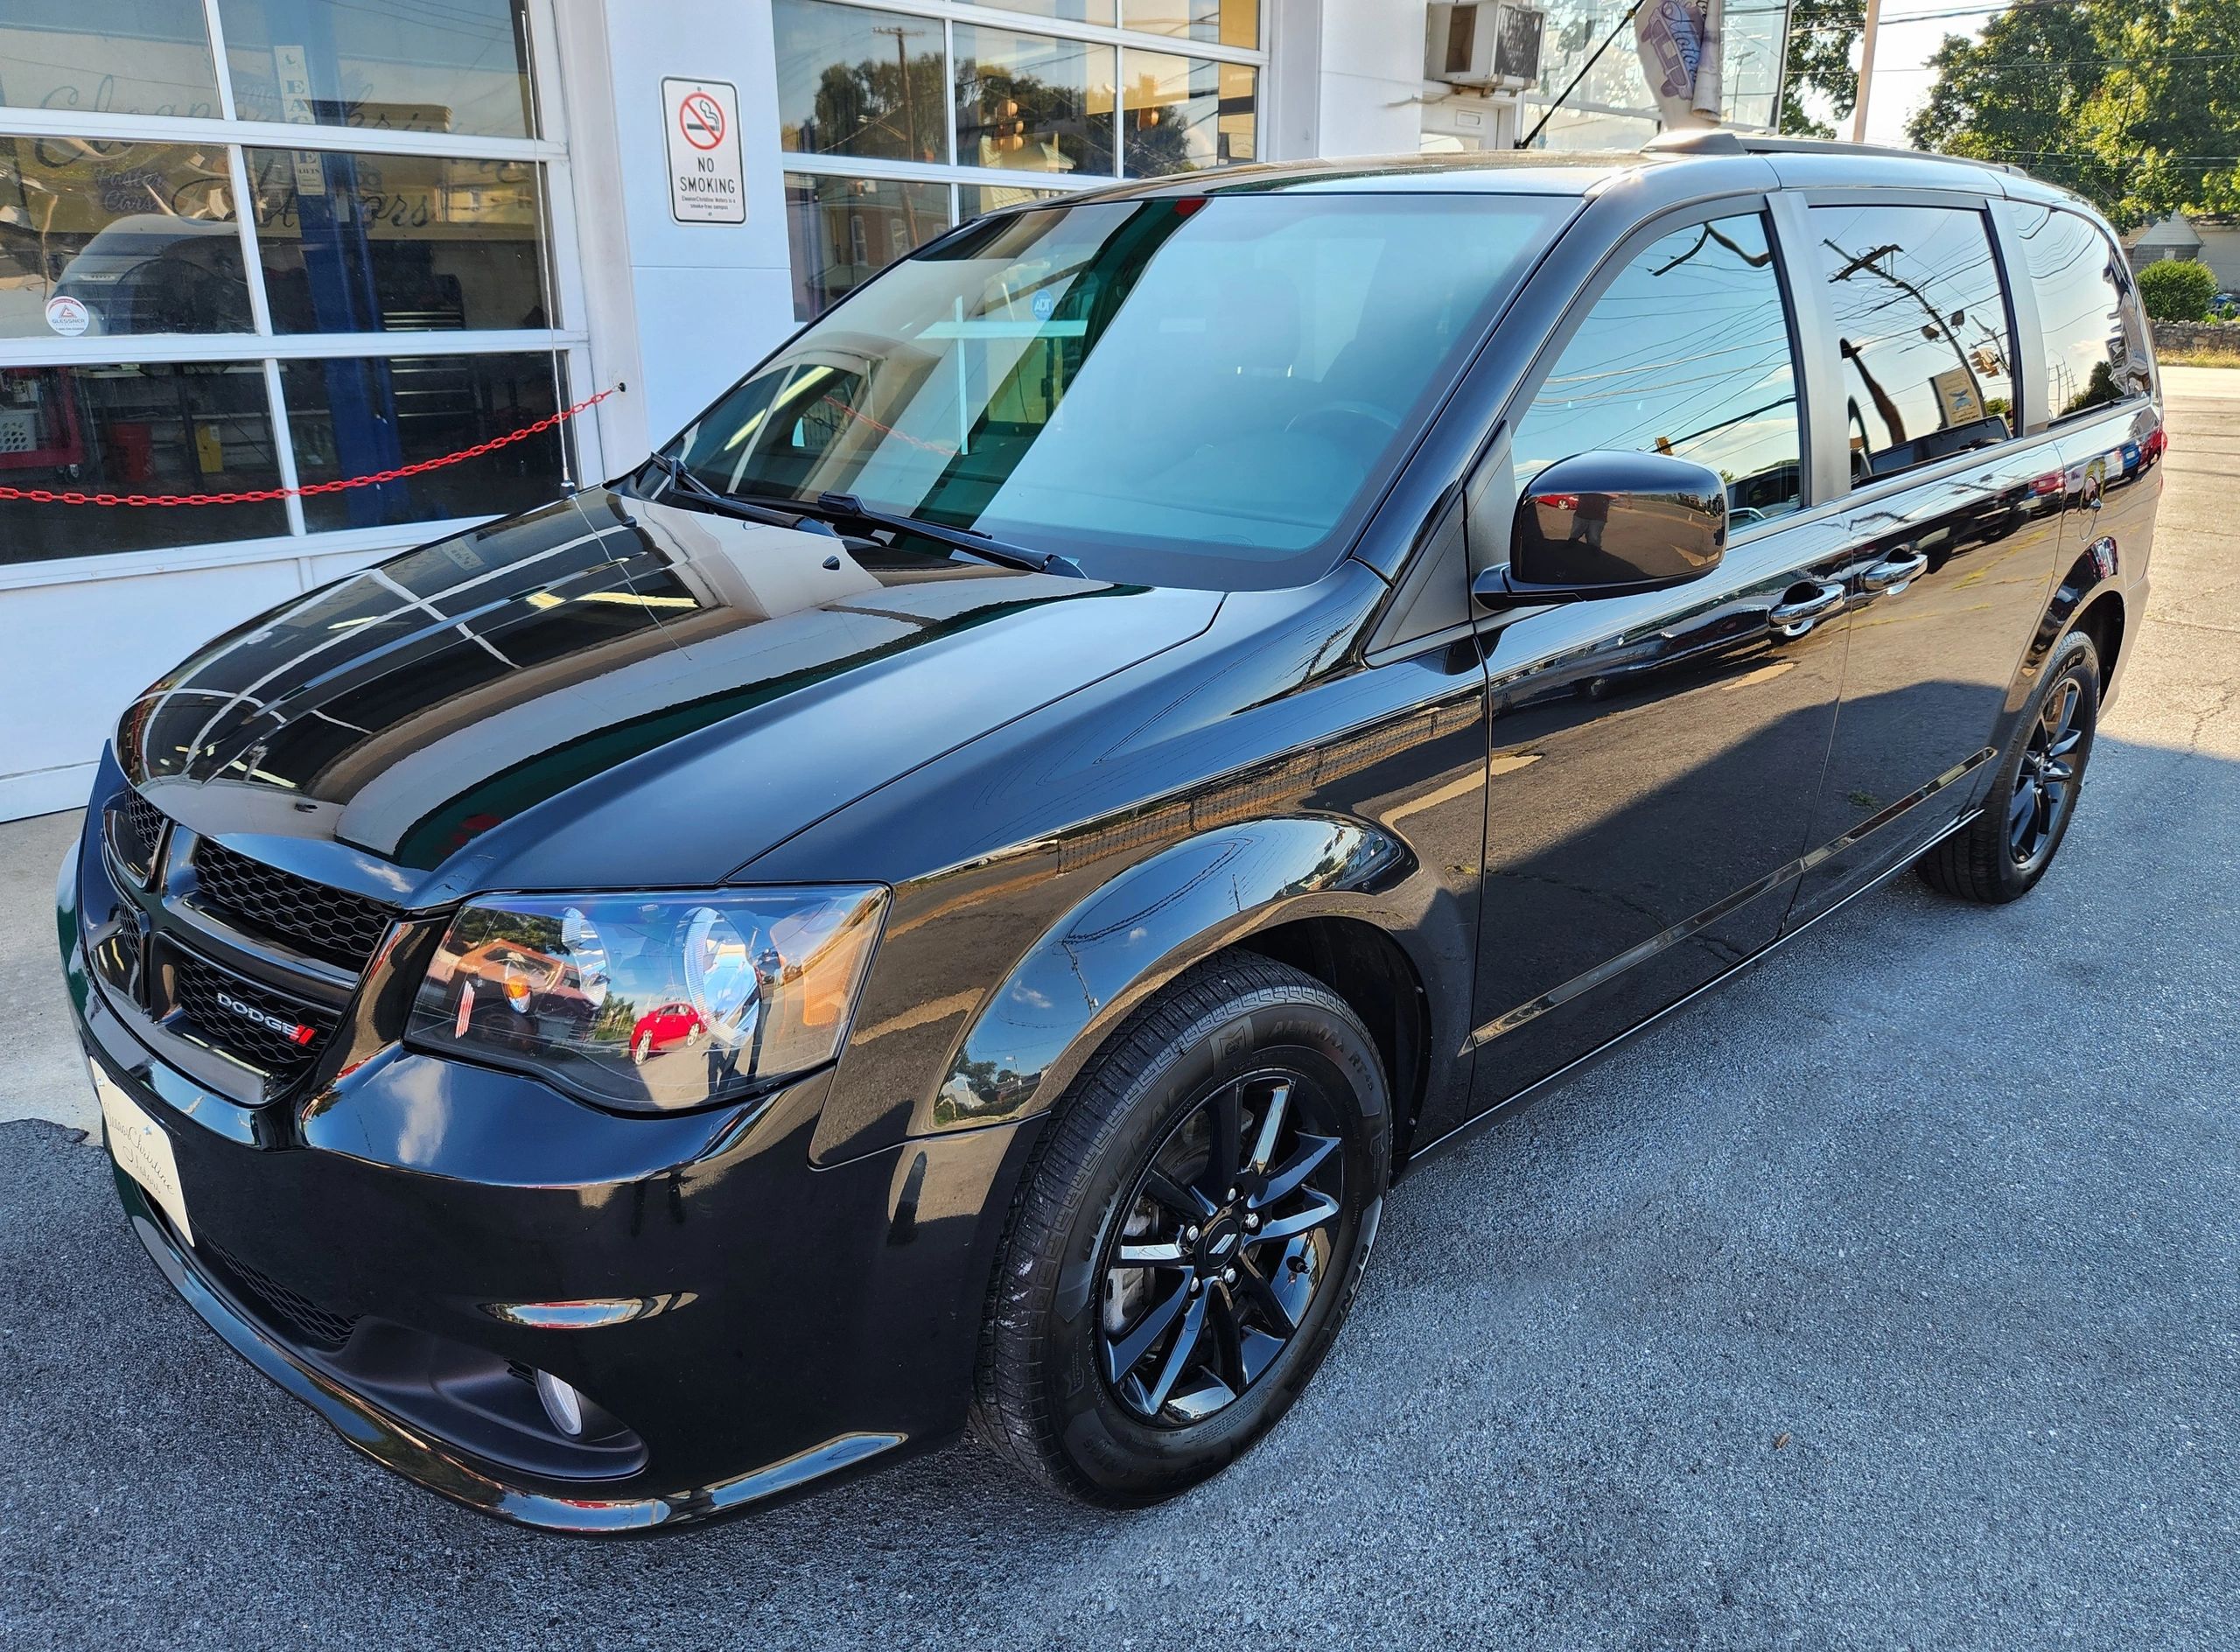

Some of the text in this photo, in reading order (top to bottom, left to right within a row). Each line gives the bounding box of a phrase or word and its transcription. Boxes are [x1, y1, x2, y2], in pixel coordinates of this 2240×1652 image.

[697, 157, 715, 172] NO
[680, 176, 735, 194] SMOKING
[1034, 298, 1051, 312] ADT
[217, 992, 300, 1040] DODGE
[1270, 1019, 1345, 1054] ALTIMAX
